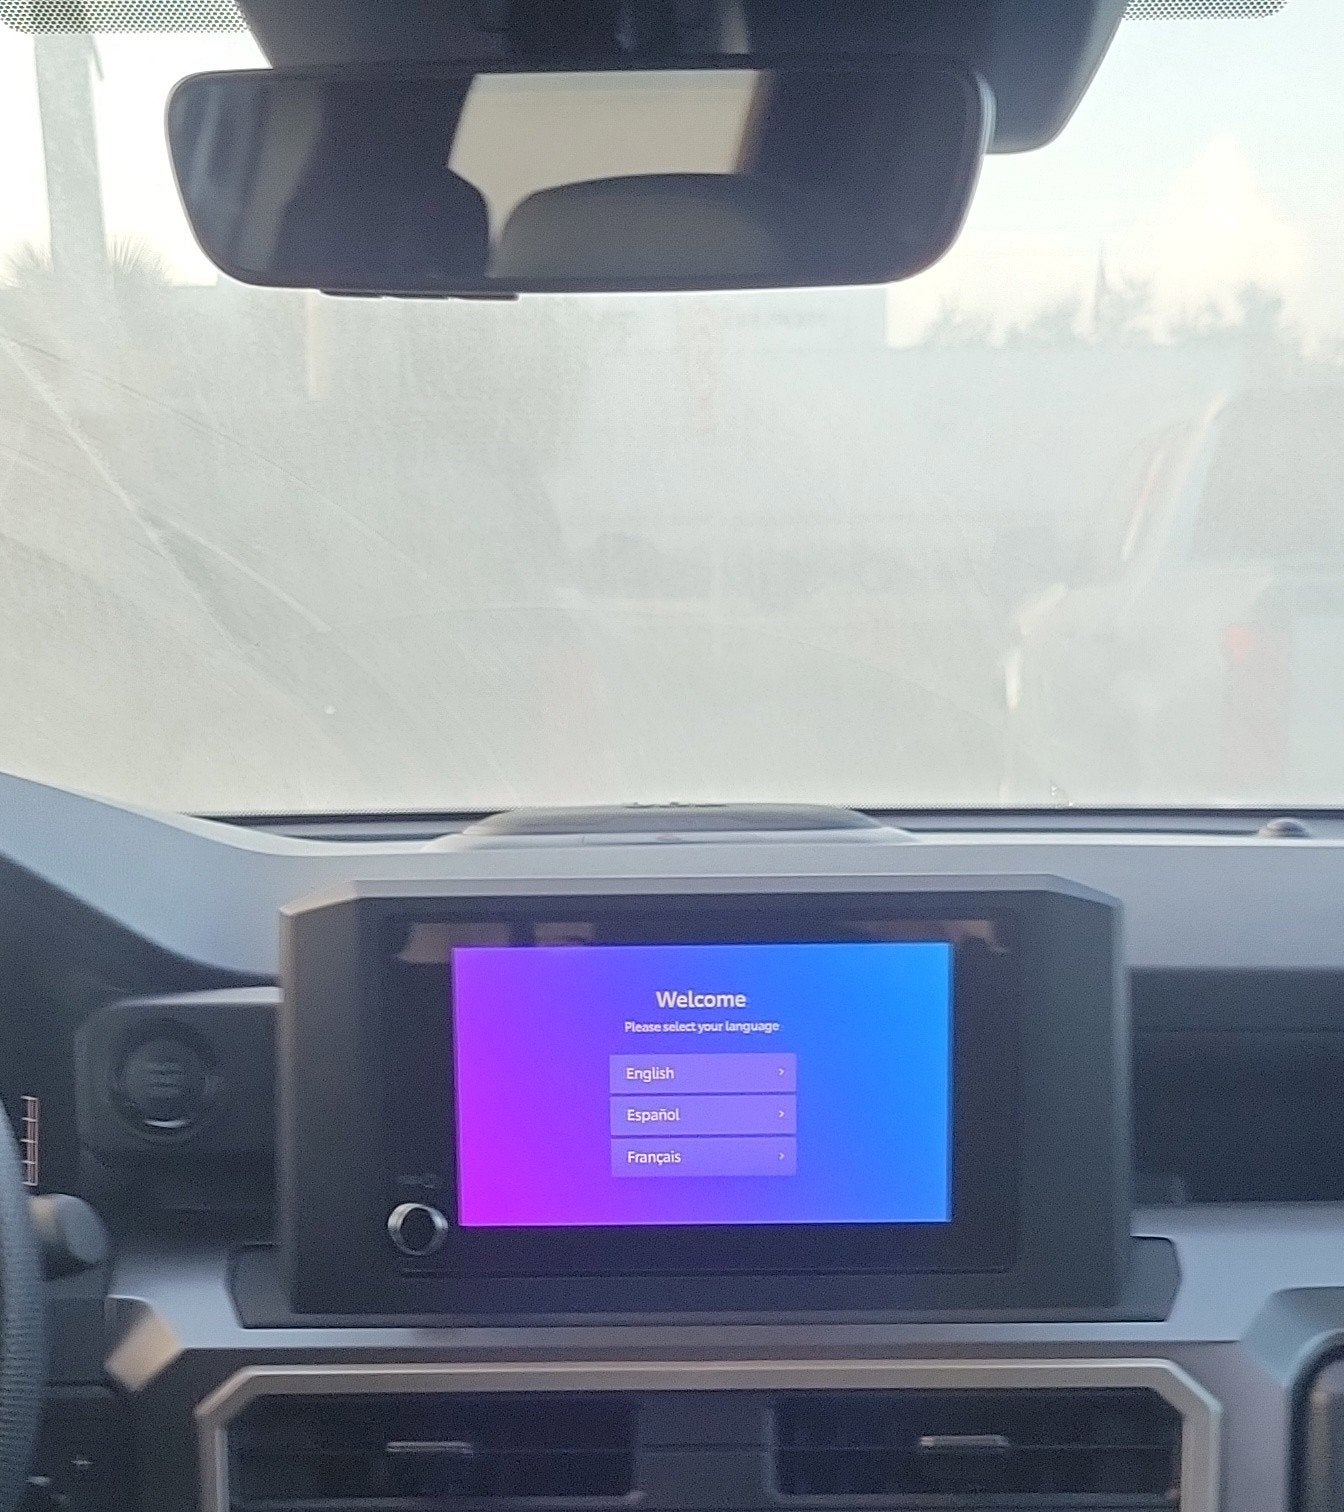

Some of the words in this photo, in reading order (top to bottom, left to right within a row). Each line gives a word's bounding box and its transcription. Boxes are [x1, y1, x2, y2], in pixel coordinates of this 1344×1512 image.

[656, 990, 747, 1008] Welcome
[624, 1021, 661, 1033] Please
[663, 1021, 696, 1032] select
[698, 1023, 723, 1034] your
[725, 1020, 780, 1034] language
[626, 1067, 675, 1083] English
[627, 1108, 680, 1124] Español
[627, 1150, 682, 1167] Français
